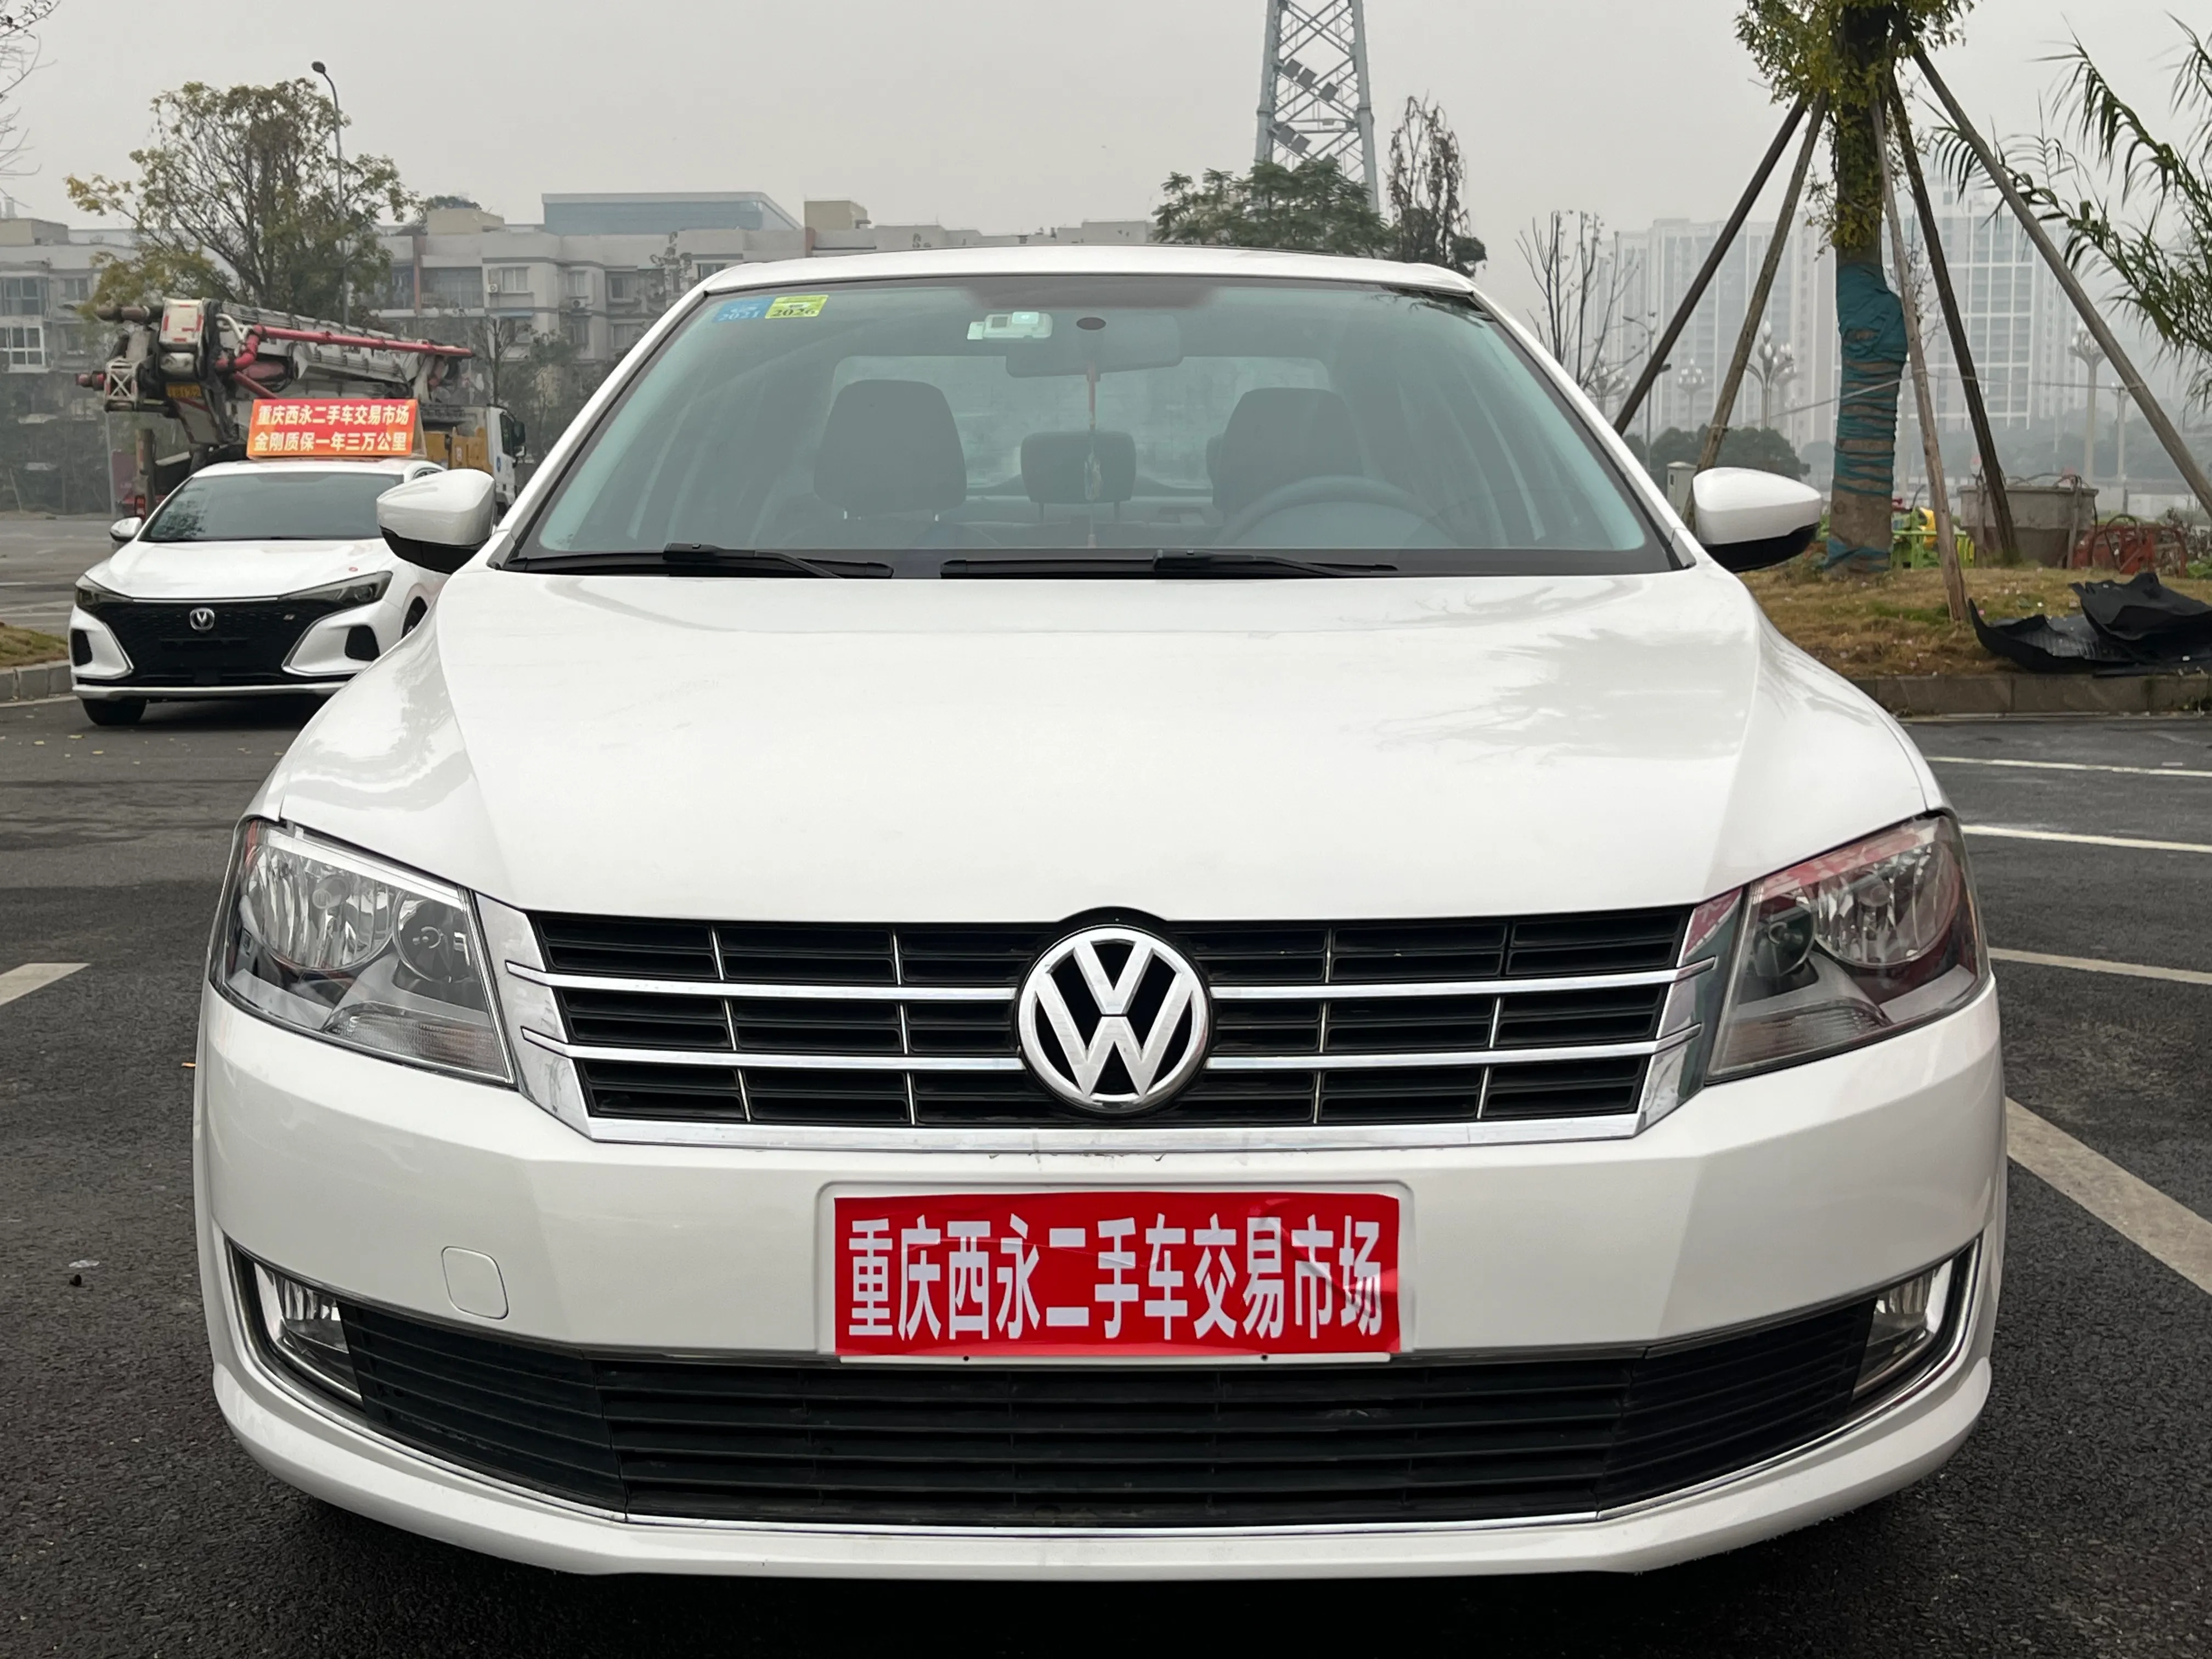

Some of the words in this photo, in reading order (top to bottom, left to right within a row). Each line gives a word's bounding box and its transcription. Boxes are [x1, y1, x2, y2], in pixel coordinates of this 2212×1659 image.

[256, 404, 410, 426] 重庆西永二手车交易市场
[253, 431, 407, 452] 金刚质保一年三万公里
[849, 1213, 1383, 1341] 重庆西永二手车交易市场
